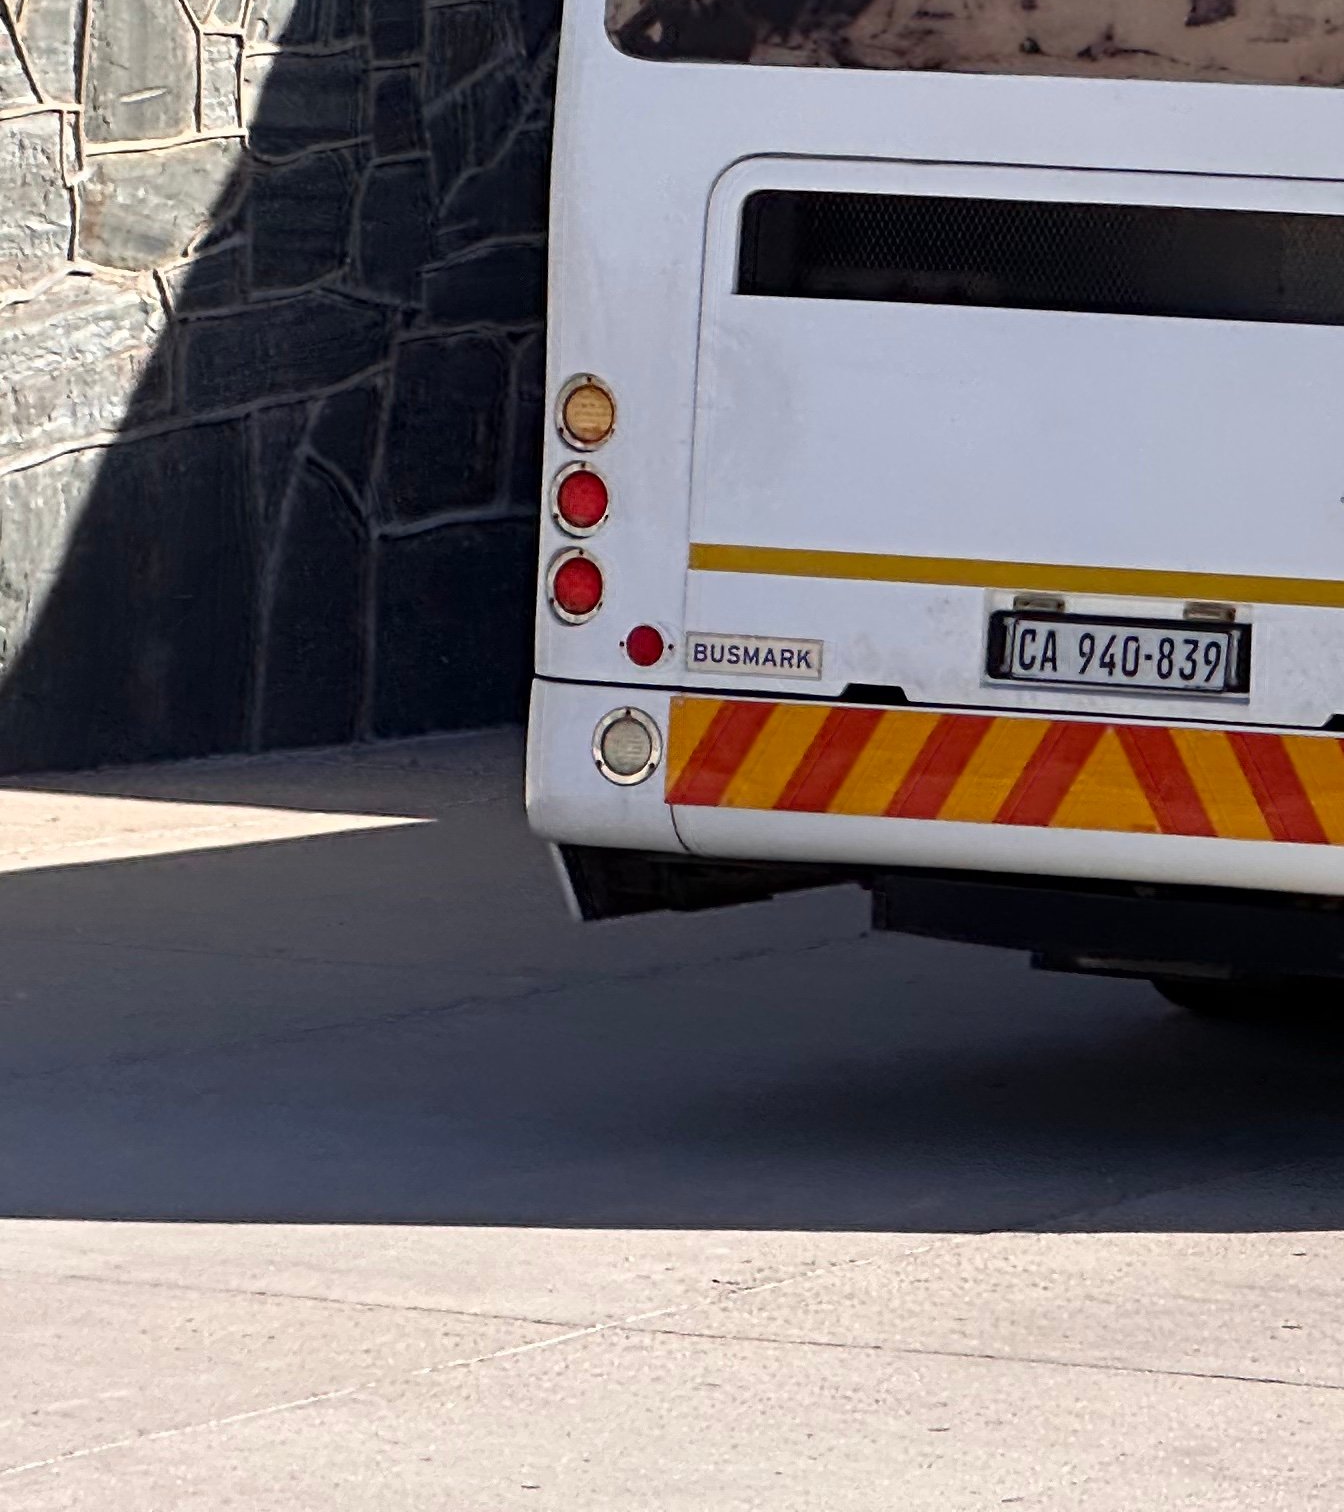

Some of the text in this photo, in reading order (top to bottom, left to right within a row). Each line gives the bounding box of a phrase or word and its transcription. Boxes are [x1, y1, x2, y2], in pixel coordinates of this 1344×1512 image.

[693, 642, 813, 669] BUSMARK
[1018, 628, 1222, 683] CA 940-839
